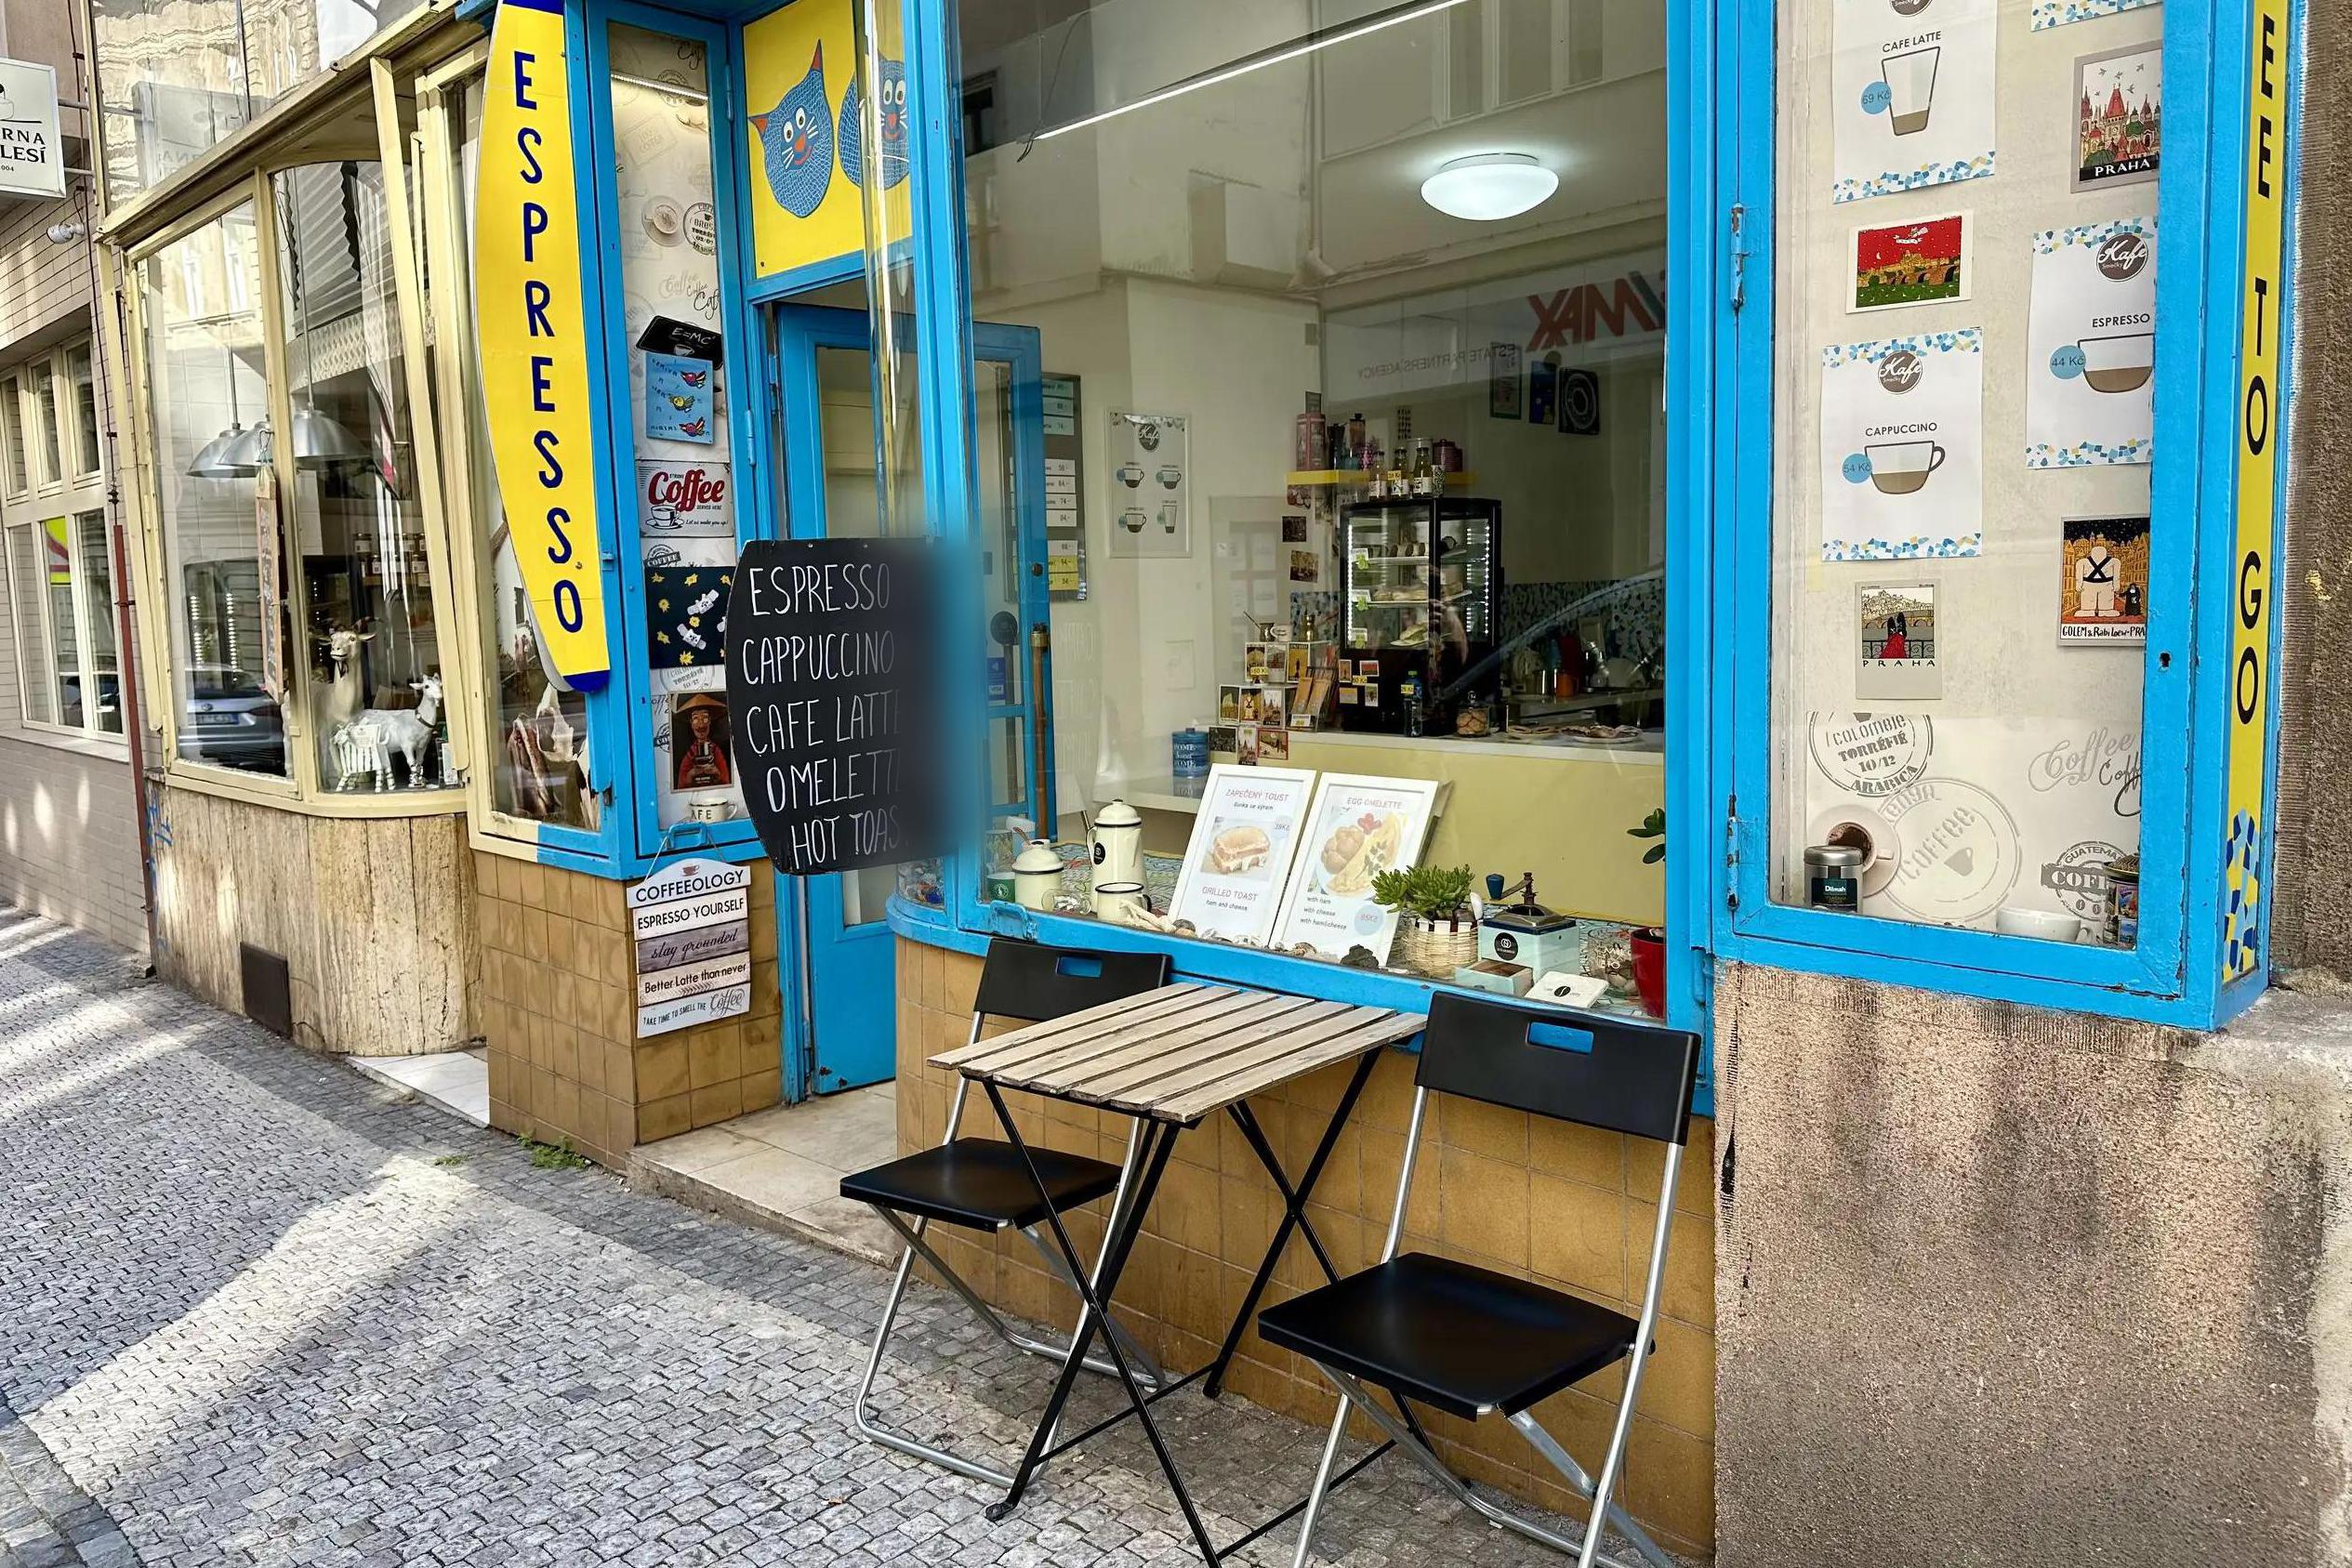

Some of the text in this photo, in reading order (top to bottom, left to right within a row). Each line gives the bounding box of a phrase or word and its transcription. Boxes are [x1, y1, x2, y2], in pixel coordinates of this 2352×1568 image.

[1883, 31, 1942, 53] CAFE LATTE
[1877, 89, 1891, 100] Kč
[2257, 13, 2275, 199] EE
[2, 127, 46, 145] RNA
[0, 144, 46, 164] LESÍ
[2094, 159, 2150, 177] PRAHA
[2097, 239, 2147, 270] Kafe
[694, 289, 720, 320] Caf
[2092, 313, 2150, 328] ESPRESSO
[514, 51, 583, 633] ESPRESSO
[1879, 356, 1921, 384] Kafe
[2051, 356, 2085, 367] 44 Kč
[2245, 277, 2267, 455] TO
[1865, 422, 1937, 437] CAPPUCCINO
[648, 469, 725, 512] Coffee
[749, 562, 890, 616] ESPRESSO
[2062, 626, 2087, 637] GOLEM
[2093, 626, 2110, 638] Rabi
[2236, 550, 2262, 724] GO
[742, 630, 895, 685] CAPPUCCINO
[747, 699, 824, 758] CAFE
[1859, 755, 1896, 772] 10/12
[2028, 727, 2134, 792] Coffee
[2099, 751, 2141, 793] Coff
[766, 748, 901, 813] OMELETT
[1850, 765, 1918, 794] ARABICA
[1264, 792, 1288, 802] TOUST
[1347, 797, 1404, 810] EGG OMELETTE
[791, 805, 901, 870] HOT TOAS
[2064, 846, 2121, 863] GUATEMA
[636, 869, 744, 903] COFFEEOLOGY
[1202, 886, 1259, 902] GRILLED TOAST
[638, 898, 745, 930] ESPRESSO YOURSELF
[651, 929, 738, 966] stay grounded
[644, 963, 747, 995] Better Latte than never
[643, 988, 746, 1025] TAKE TIME TO SMELL THE Coffee
